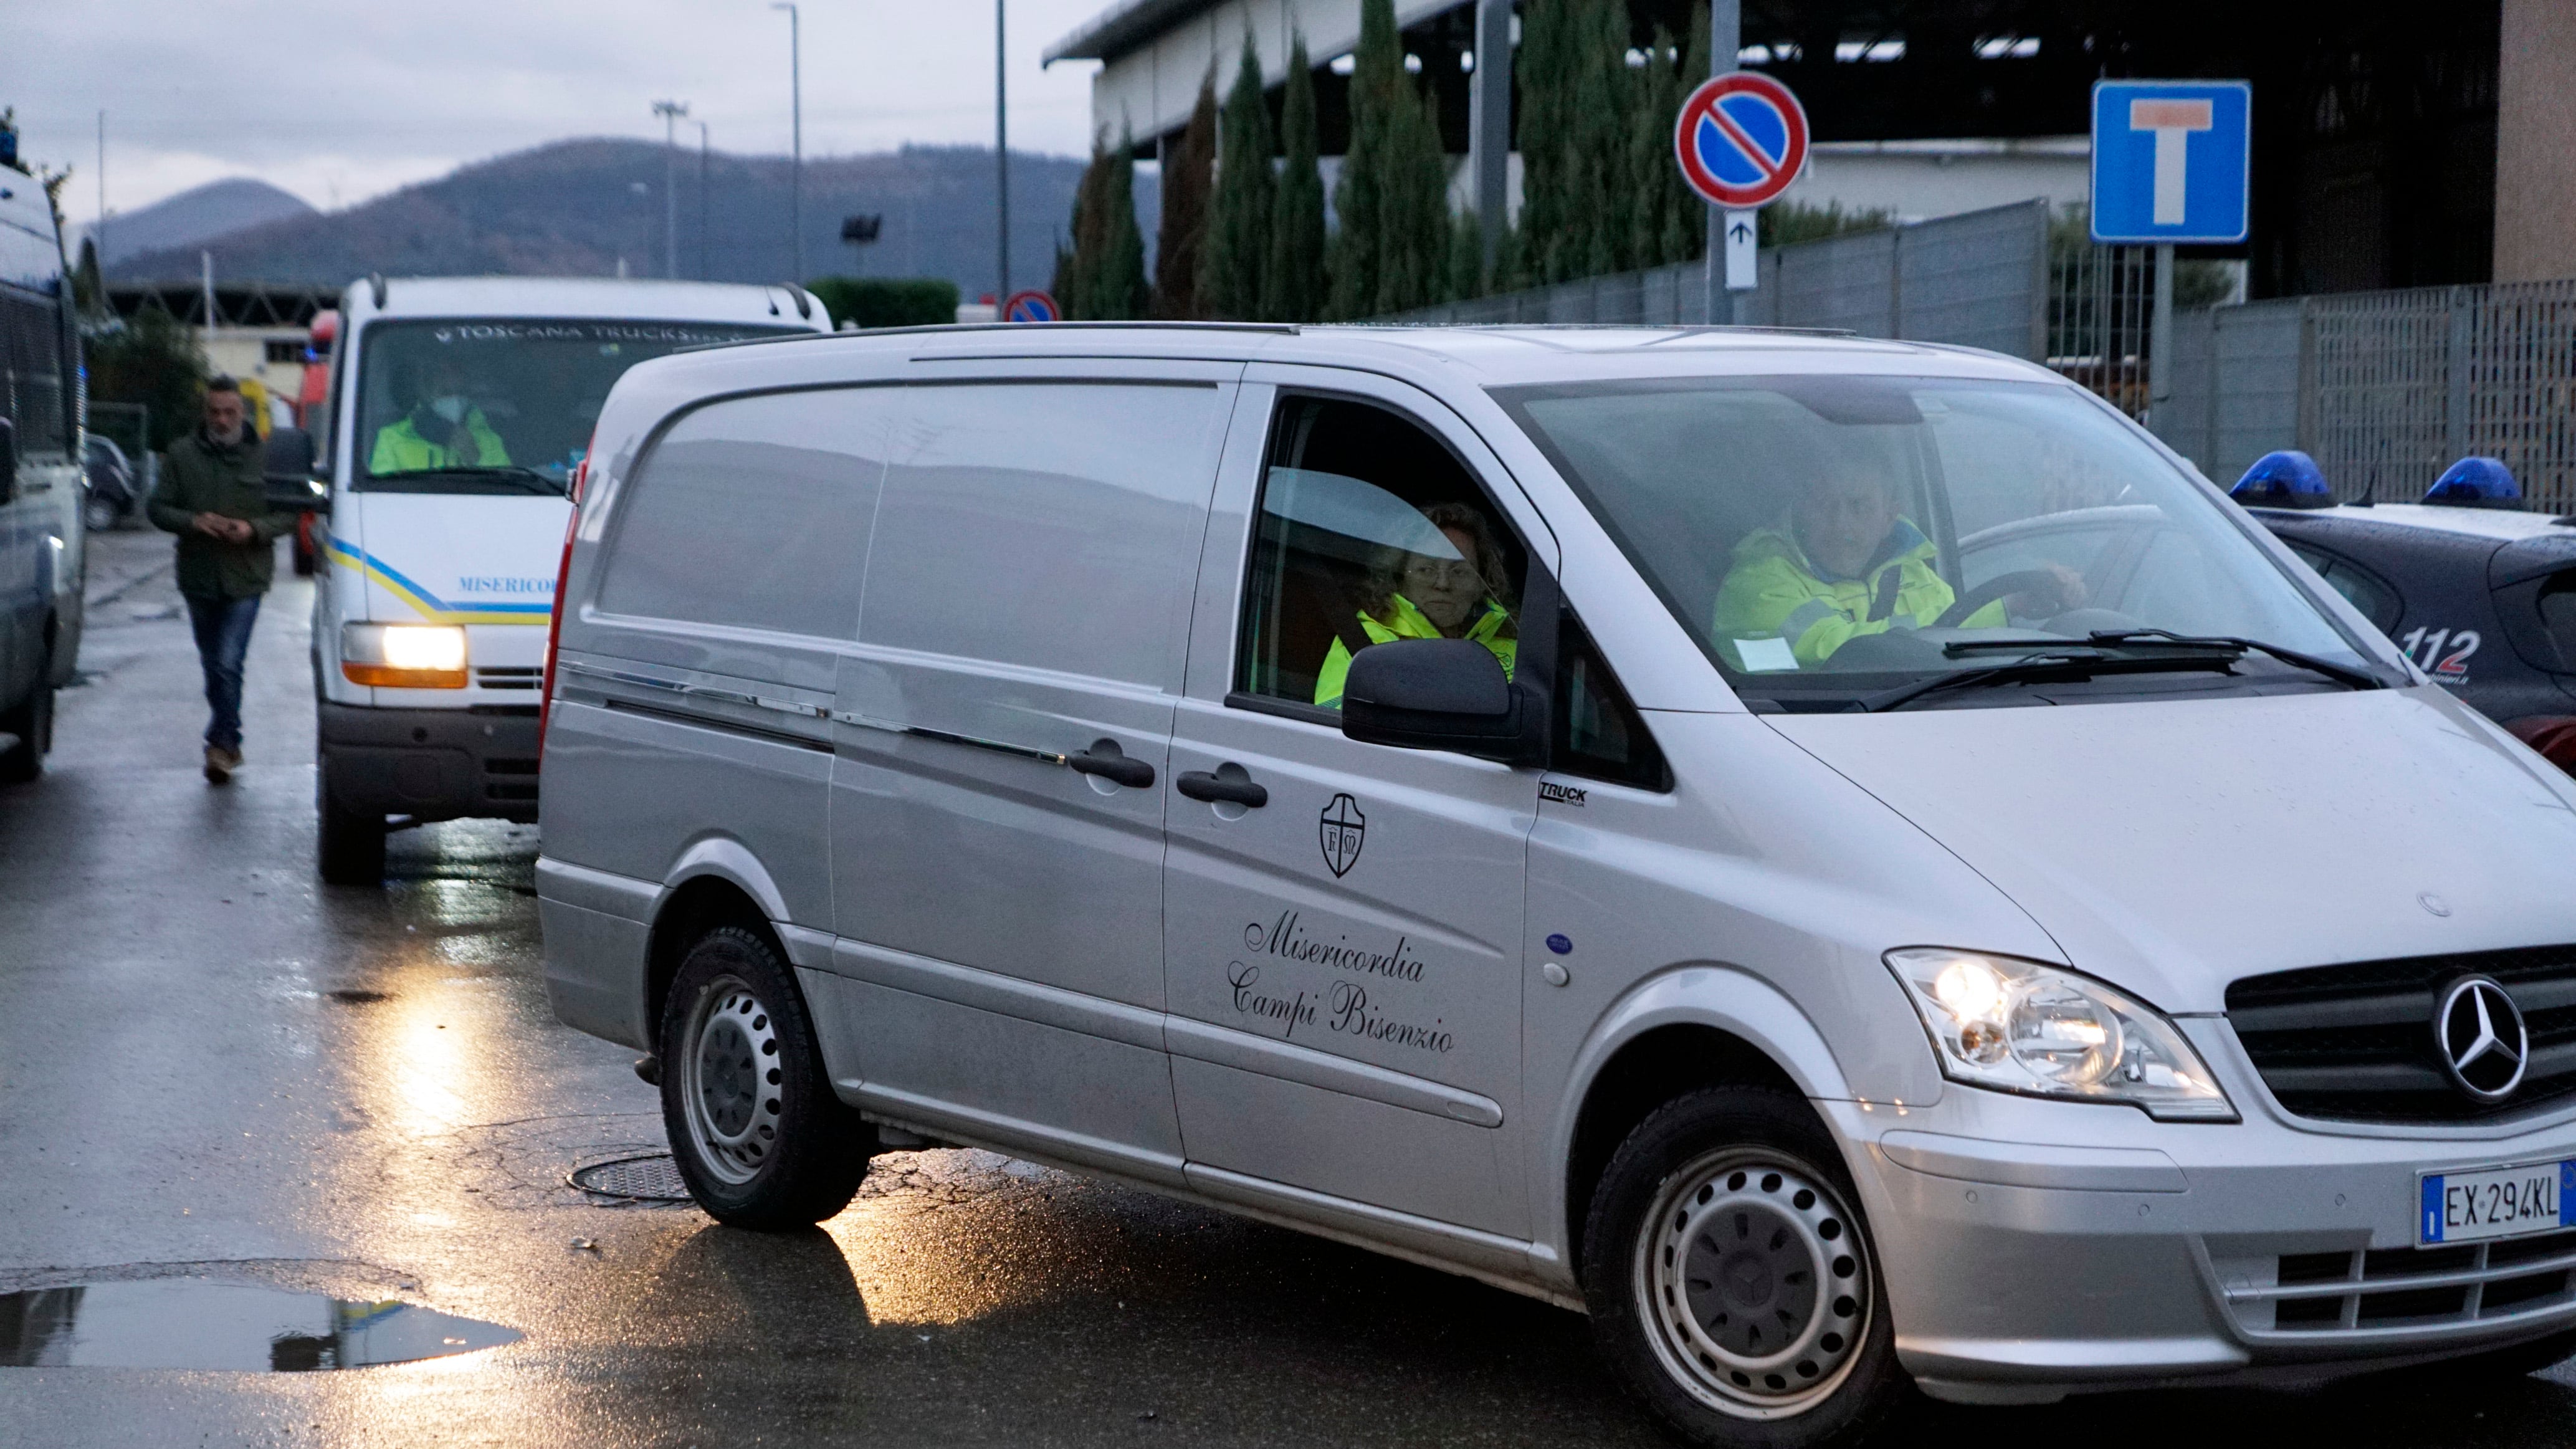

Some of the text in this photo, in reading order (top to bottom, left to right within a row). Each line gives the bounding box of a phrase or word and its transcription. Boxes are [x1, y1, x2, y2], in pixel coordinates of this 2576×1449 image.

[2403, 626, 2481, 674] 112
[1539, 782, 1588, 802] TRUCK
[1244, 909, 1425, 982] Misericordia
[1228, 960, 1454, 1053] Campi Bisenzio
[2446, 1175, 2558, 1227] EX 294KL
